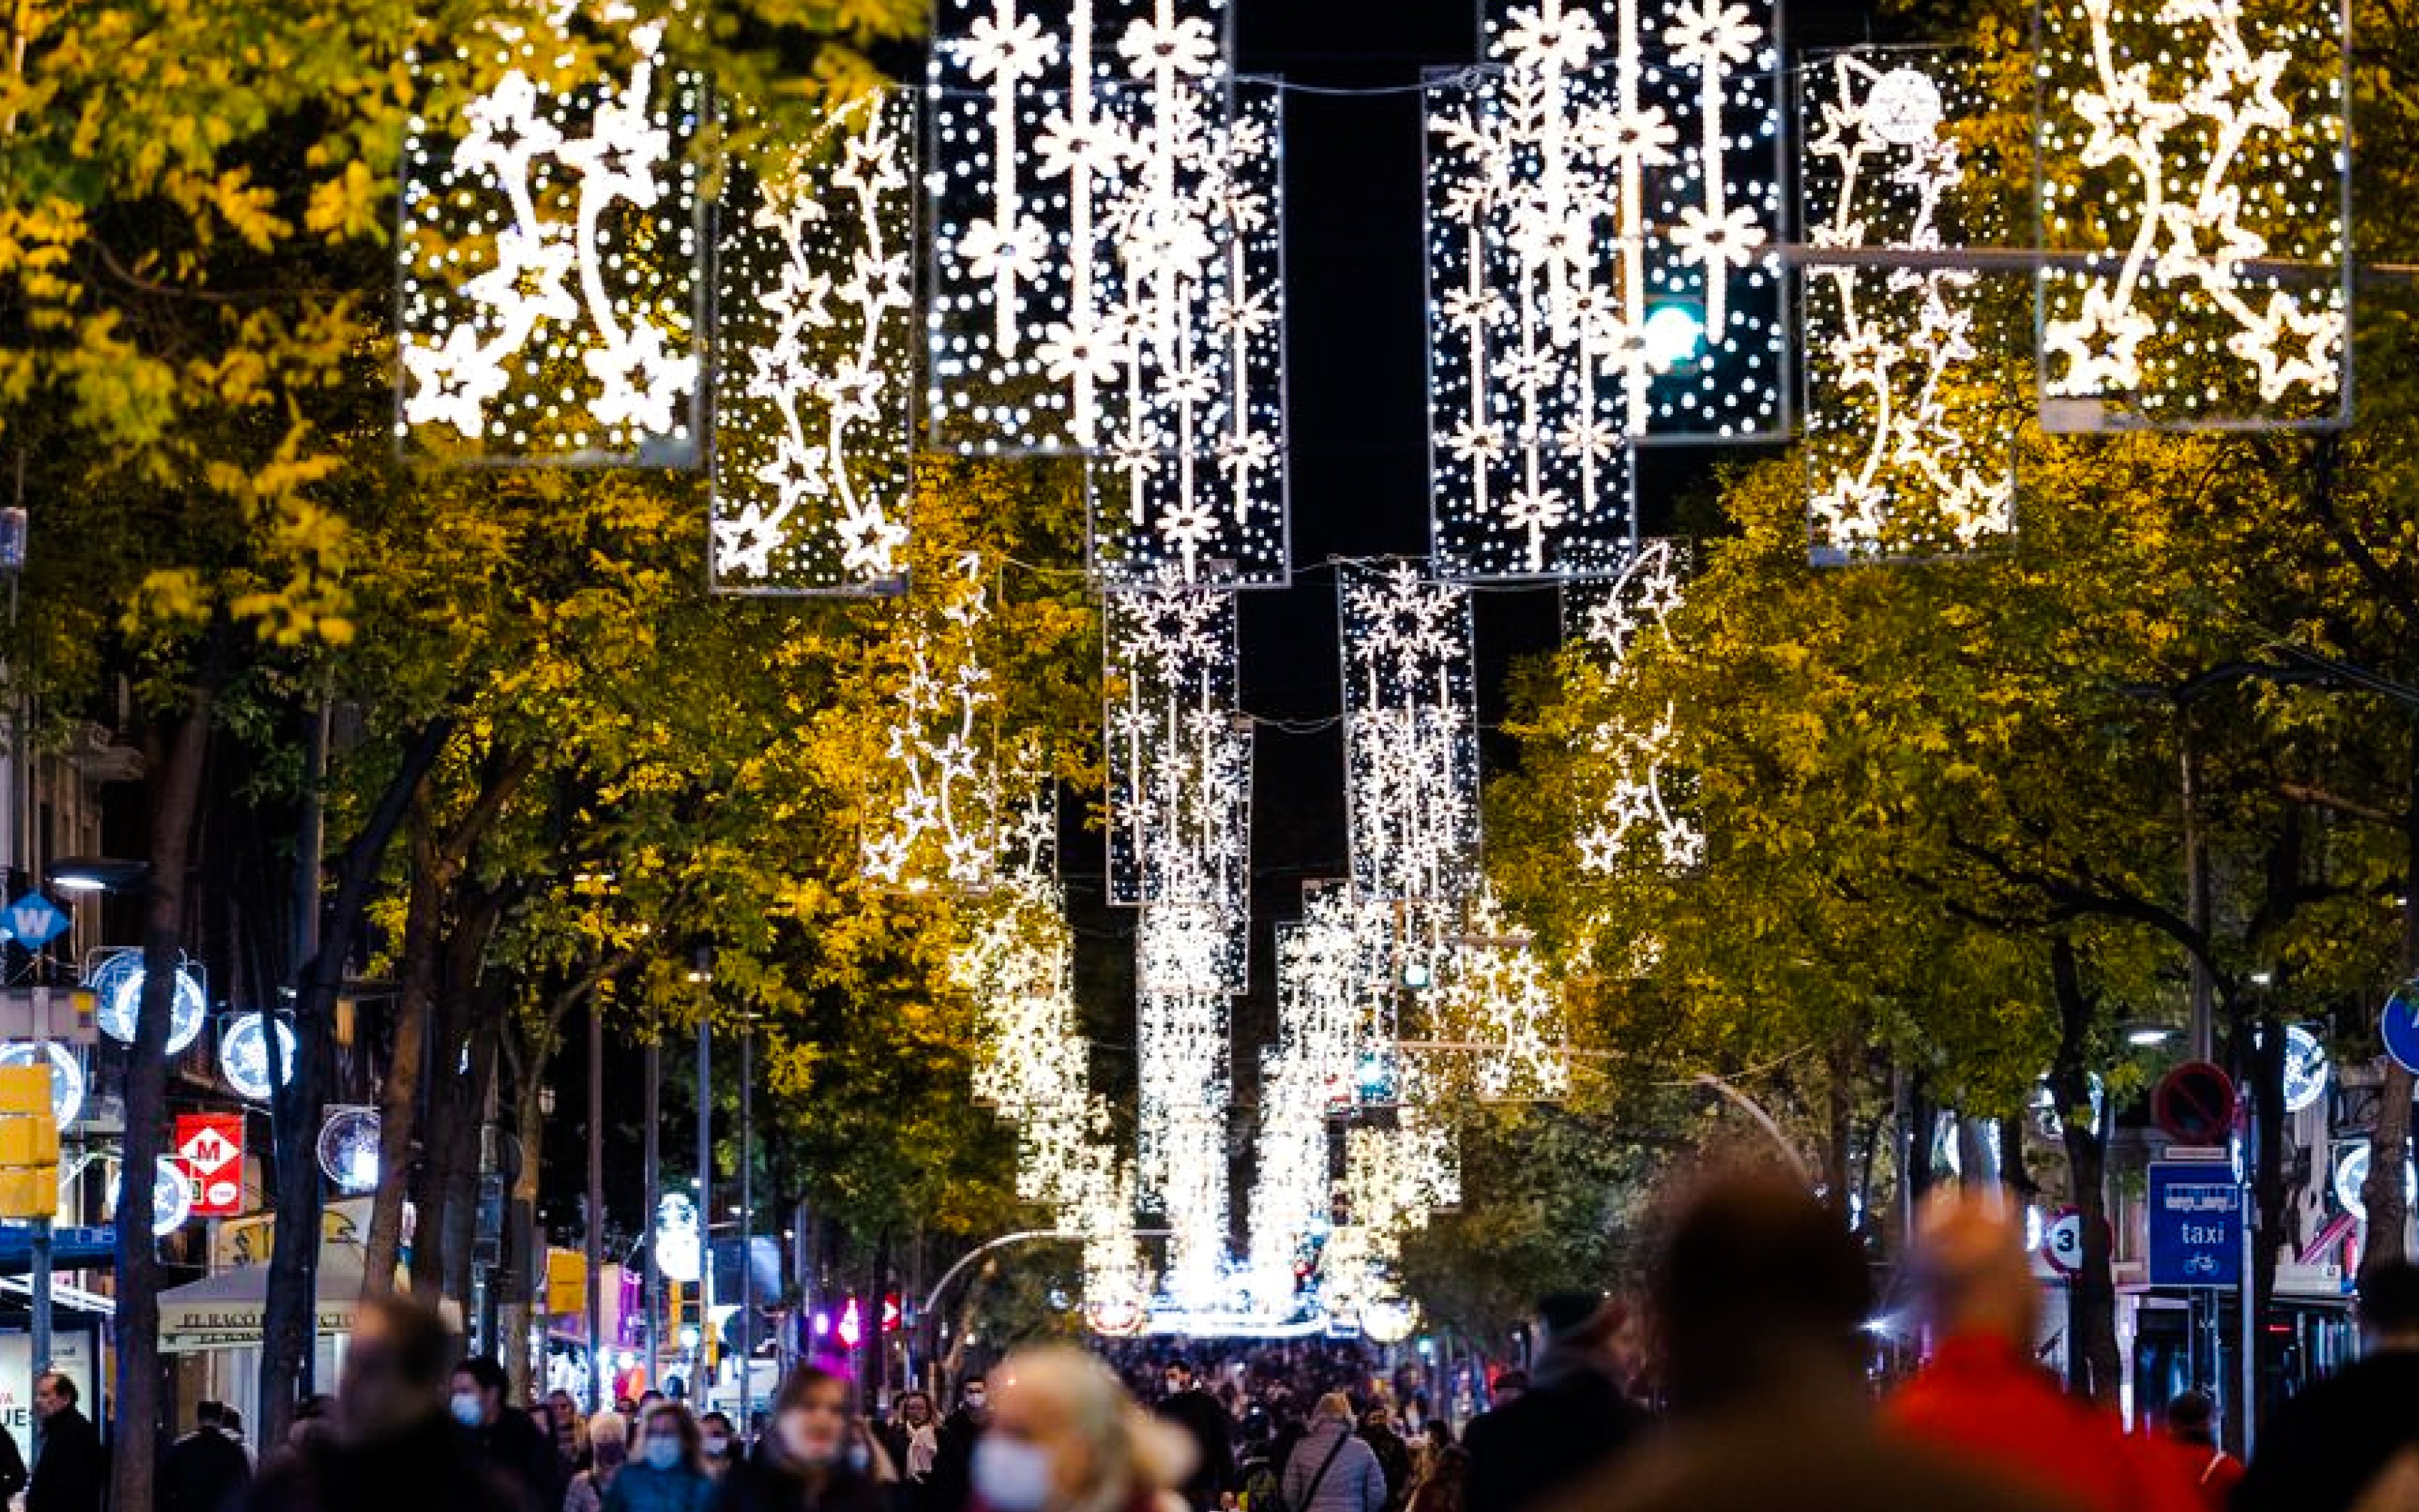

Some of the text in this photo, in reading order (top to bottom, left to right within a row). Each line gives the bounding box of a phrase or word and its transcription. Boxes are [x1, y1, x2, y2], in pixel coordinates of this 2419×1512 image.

[13, 907, 54, 938] W
[197, 1139, 221, 1162] M
[2181, 1222, 2224, 1244] taxi
